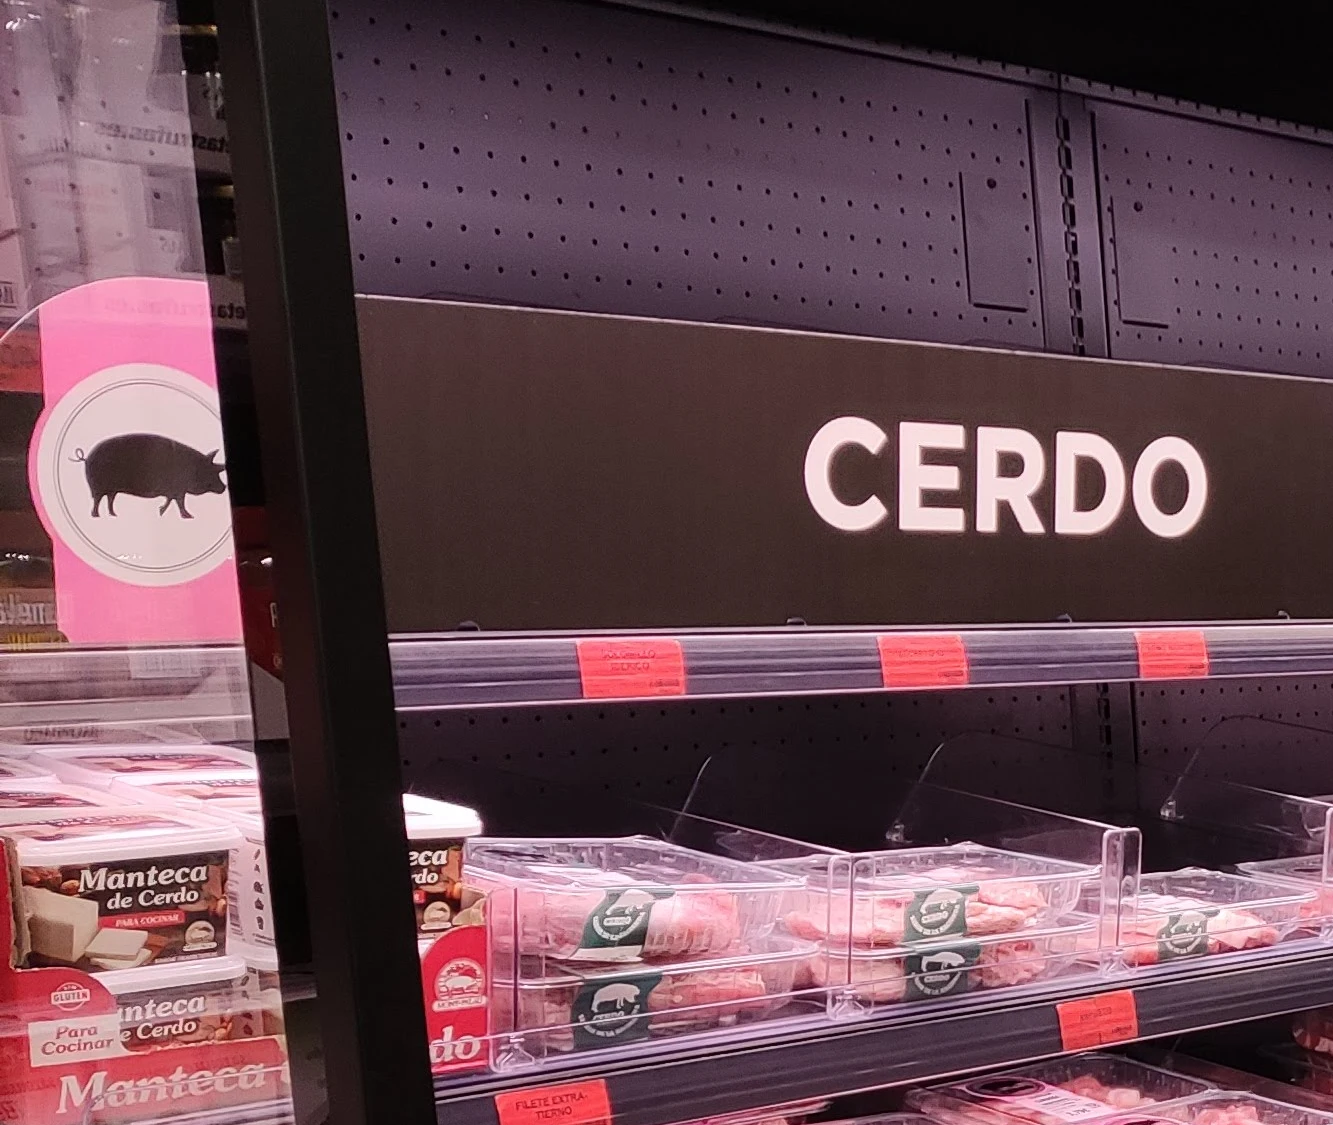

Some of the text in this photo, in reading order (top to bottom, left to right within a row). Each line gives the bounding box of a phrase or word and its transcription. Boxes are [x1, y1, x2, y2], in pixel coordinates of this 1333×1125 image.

[803, 415, 1208, 539] CERDO
[78, 865, 209, 893] Manteca
[106, 888, 200, 911] de Cerdo
[115, 912, 181, 928] PARA COCINAR
[53, 990, 90, 1003] GLUTEN
[118, 996, 207, 1023] nteca
[56, 1025, 98, 1041] Para
[137, 1019, 198, 1040] Cerdo
[41, 1037, 114, 1057] Cocinar
[56, 1062, 267, 1115] Manteca
[515, 1097, 549, 1111] FILETE
[535, 1105, 573, 1120] TIERNO
